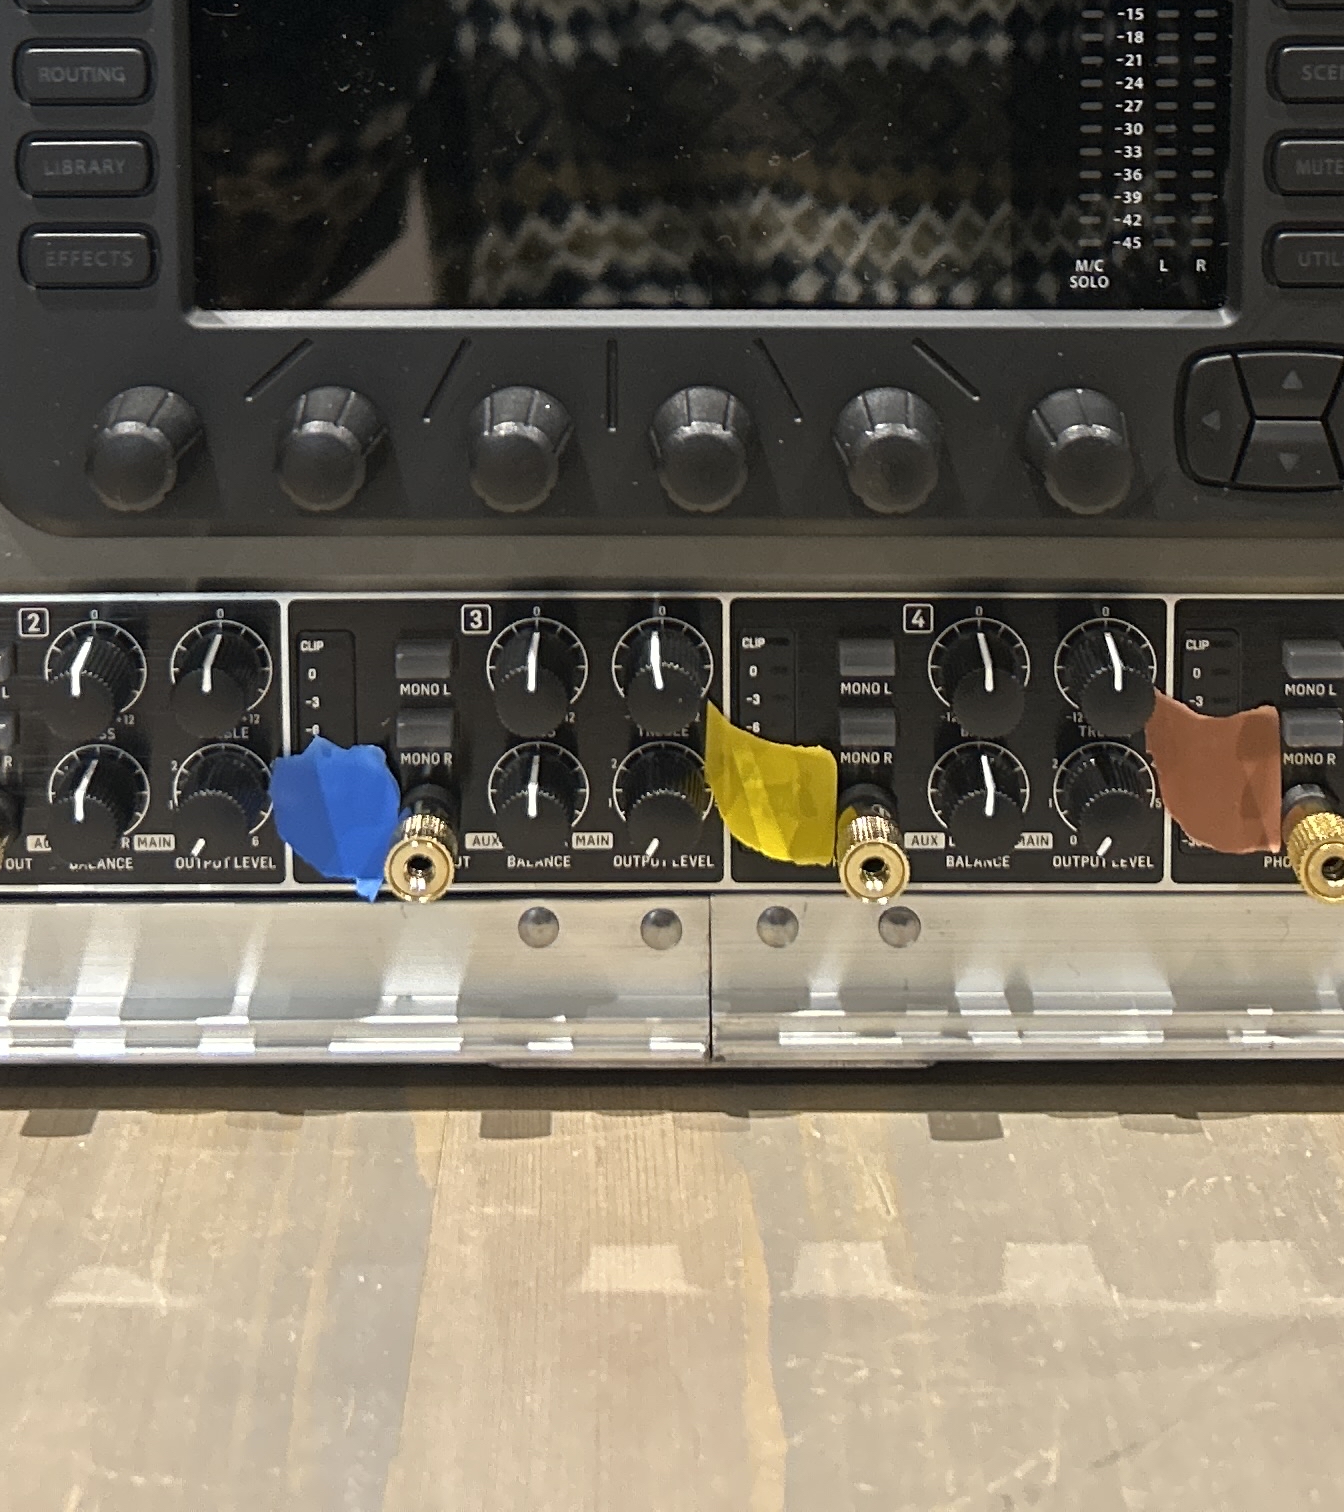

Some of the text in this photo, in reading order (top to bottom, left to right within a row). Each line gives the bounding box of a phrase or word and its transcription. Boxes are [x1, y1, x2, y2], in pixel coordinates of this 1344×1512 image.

[1118, 8, 1144, 20] -15
[1117, 31, 1143, 43] -18
[1116, 54, 1141, 66] -21
[37, 66, 125, 83] ROUTING
[1116, 77, 1143, 89] -24
[1116, 100, 1143, 112] -27
[1115, 123, 1143, 135] -30
[1115, 146, 1142, 158] -33
[43, 158, 125, 176] LIBRARY
[1296, 159, 1344, 175] MUTE
[1114, 169, 1142, 181] -36
[1114, 191, 1142, 203] -39
[1114, 214, 1141, 226] -42
[1113, 237, 1141, 249] -45
[45, 250, 133, 268] EFFECTS
[1196, 259, 1206, 271] R
[1076, 259, 1103, 272] M/C
[1160, 260, 1168, 271] L
[1070, 276, 1109, 288] SOLO
[28, 613, 40, 632] 2
[470, 610, 482, 629] 3
[912, 609, 925, 628] 4
[2, 687, 9, 699] L
[400, 683, 450, 695] MONO L
[4, 756, 13, 767] R
[401, 752, 452, 767] MONO R
[576, 835, 609, 847] MAIN
